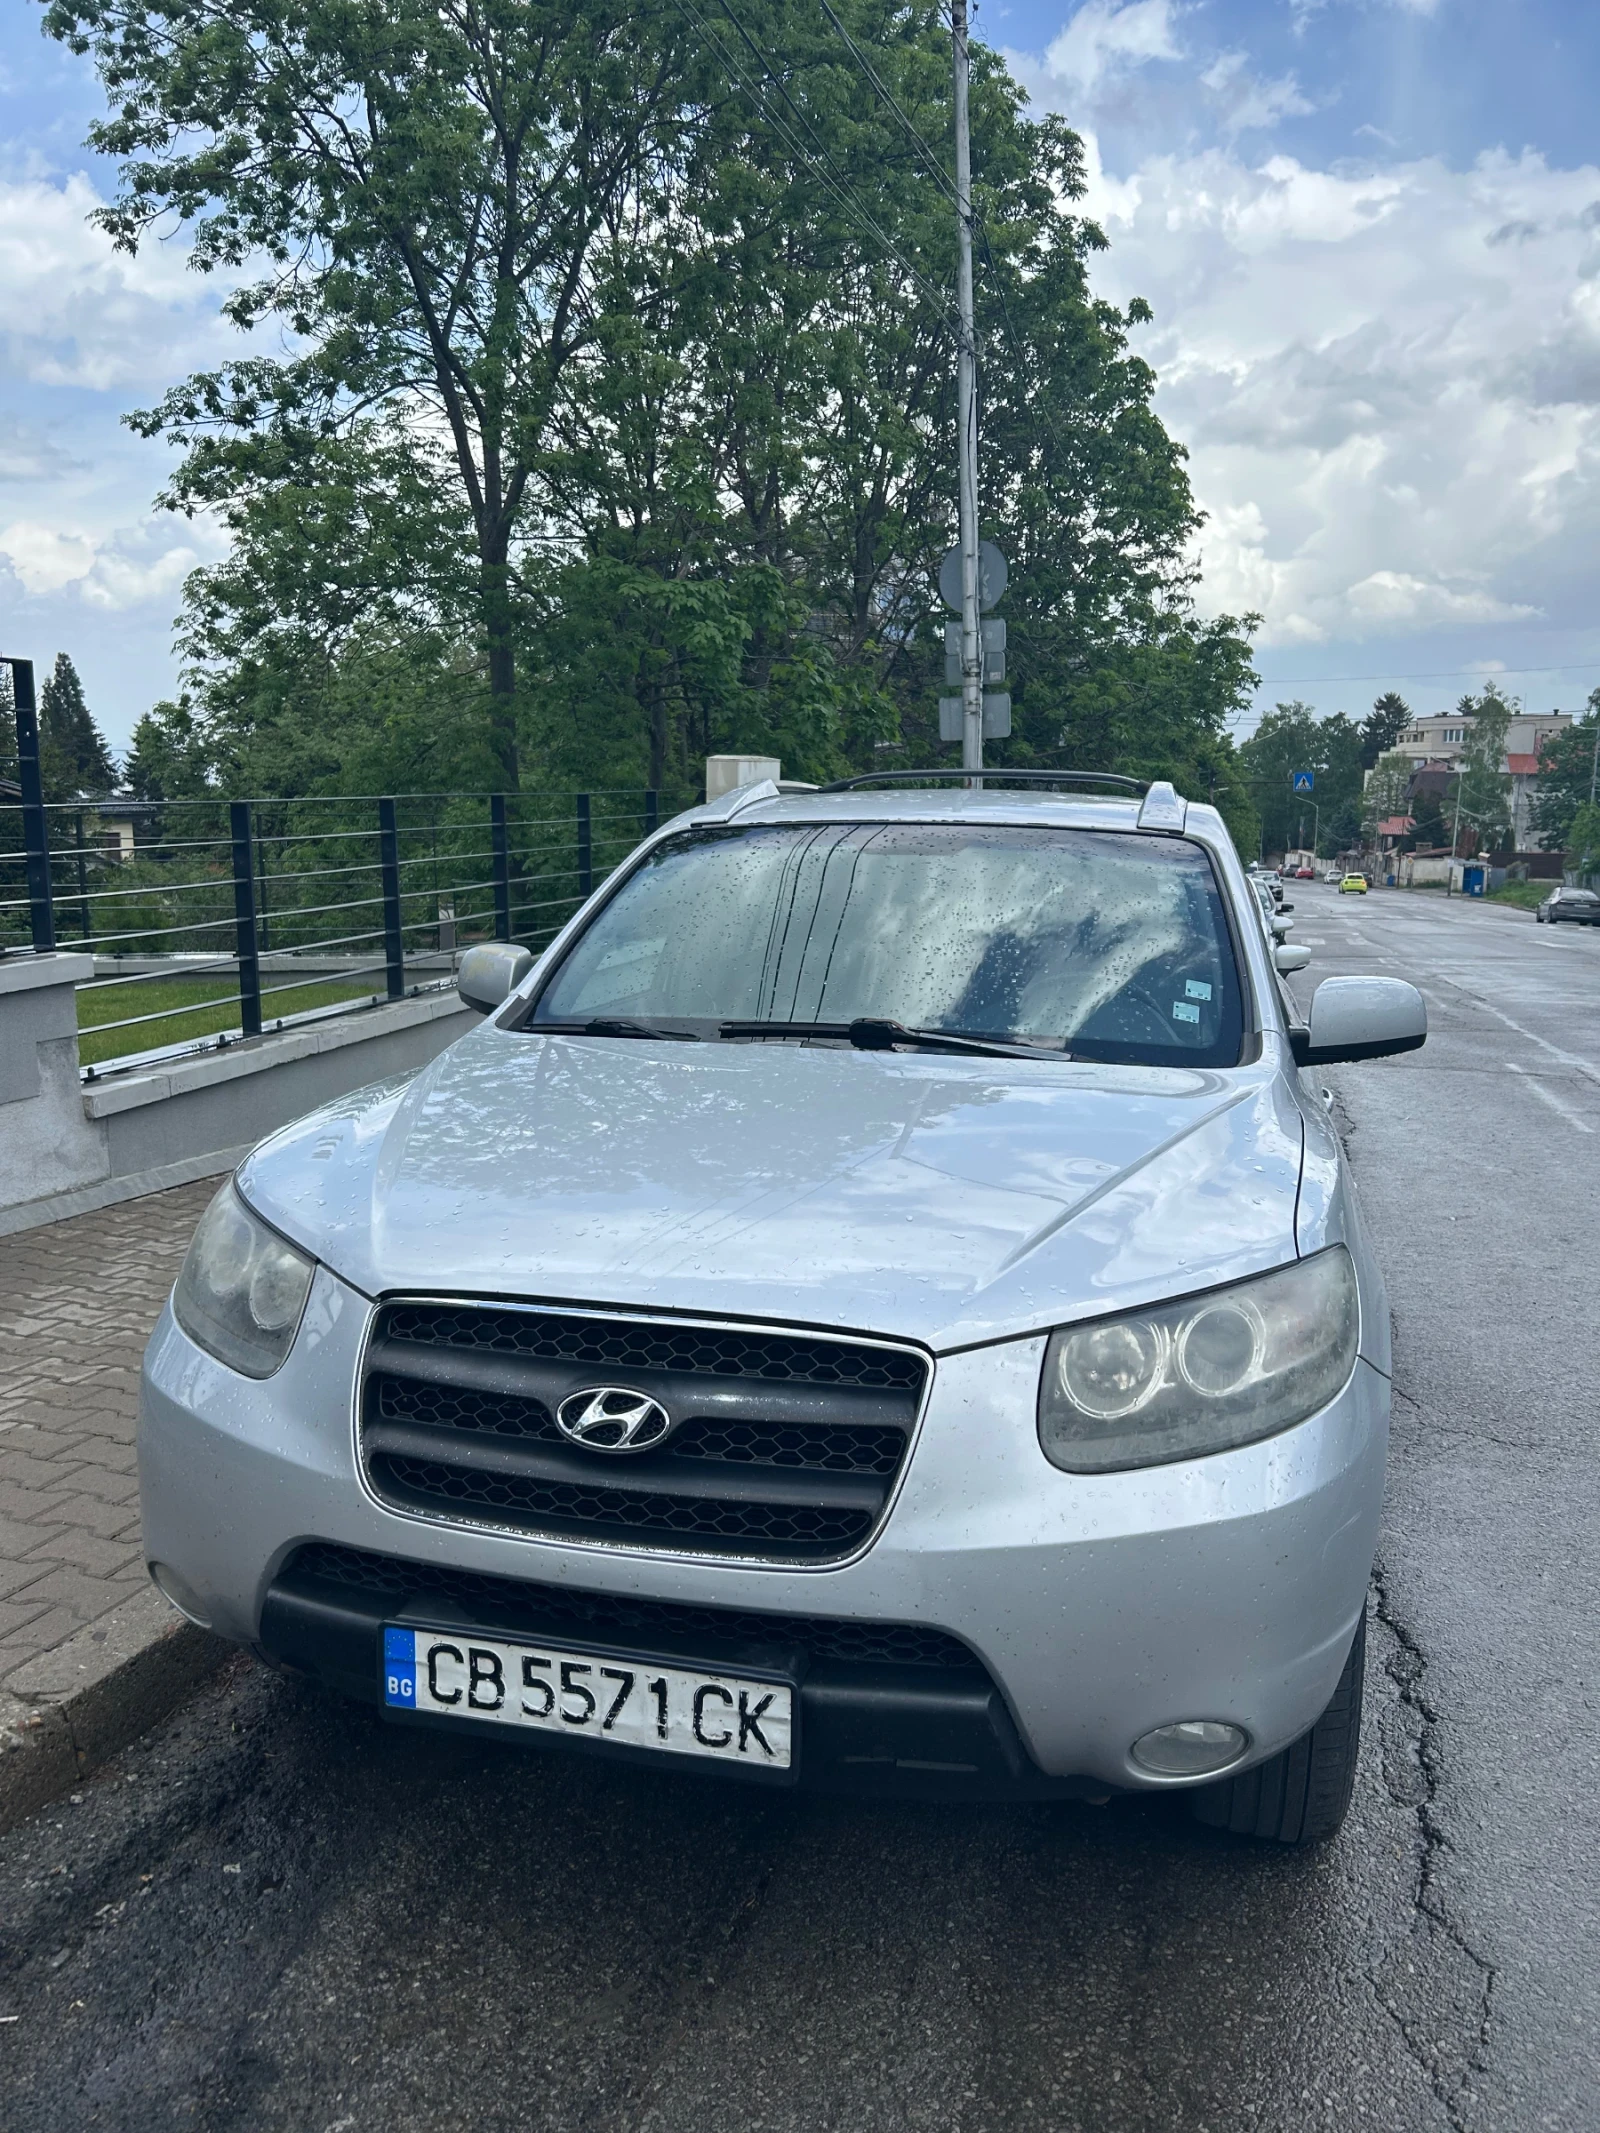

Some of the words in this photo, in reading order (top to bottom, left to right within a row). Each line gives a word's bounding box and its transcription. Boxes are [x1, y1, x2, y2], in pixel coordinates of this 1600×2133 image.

[387, 1676, 413, 1698] BG
[427, 1643, 506, 1711] CB
[521, 1655, 671, 1740] 5571
[692, 1683, 778, 1757] CK
